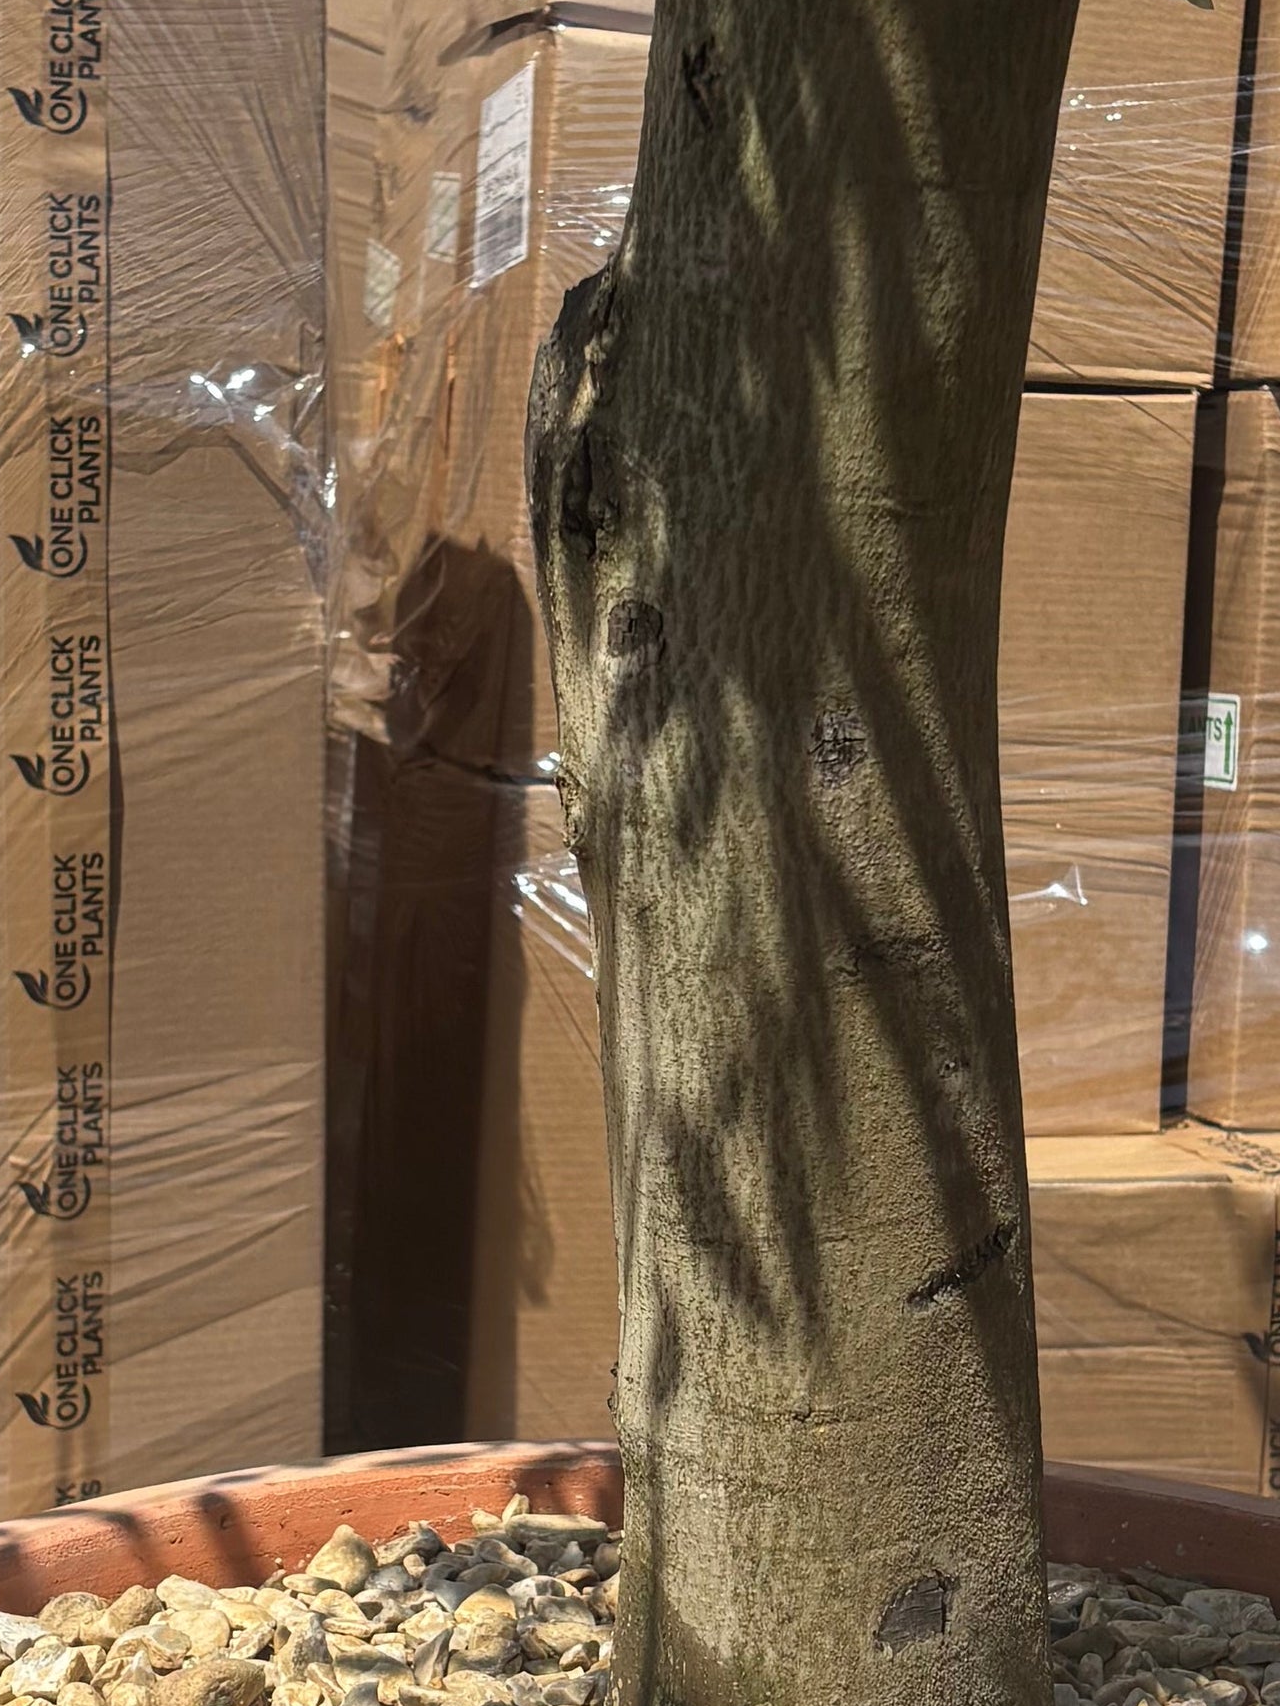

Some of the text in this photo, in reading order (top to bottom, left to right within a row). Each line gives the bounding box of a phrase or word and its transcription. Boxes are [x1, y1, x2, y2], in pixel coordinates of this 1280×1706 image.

[48, 61, 75, 125] ONE
[47, 194, 75, 348] ONE CLICK
[77, 194, 102, 305] PLANTS
[49, 415, 75, 569] ONE CLICK
[77, 415, 102, 525] PLANTS
[50, 635, 76, 788] ONE CLICK
[79, 633, 103, 744] PLANTS
[53, 852, 78, 1003] ONE CLICK
[81, 851, 105, 957] PLANTS
[55, 1064, 79, 1213] ONE CLICK
[81, 1061, 104, 1167] PLANTS
[55, 1275, 80, 1423] ONE CLICK
[82, 1270, 105, 1377] PLANTS
